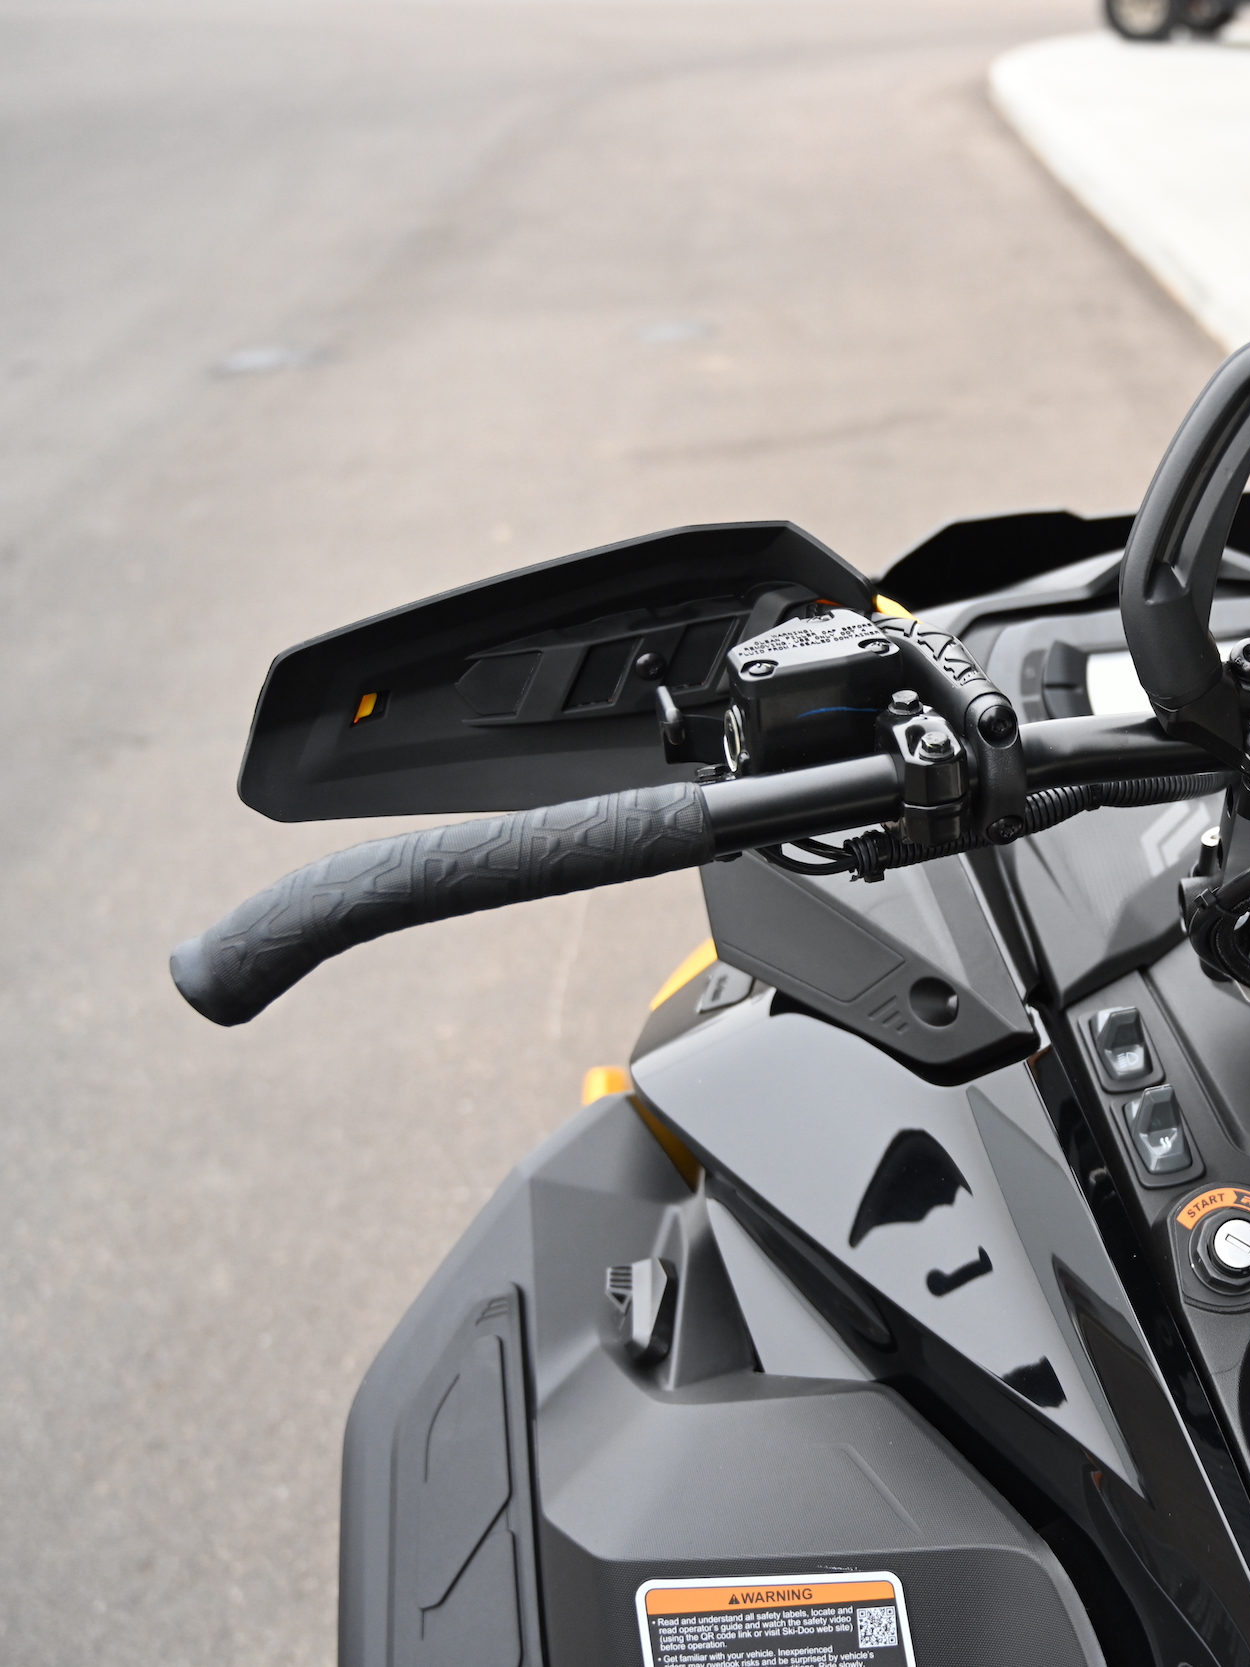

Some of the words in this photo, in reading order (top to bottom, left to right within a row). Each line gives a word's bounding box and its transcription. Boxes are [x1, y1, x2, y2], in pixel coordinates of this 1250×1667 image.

[738, 649, 765, 657] FLUID
[800, 637, 831, 647] SEALED
[834, 630, 881, 642] CONTAINER
[754, 636, 781, 646] CLEAN
[786, 632, 817, 641] FILLER
[842, 622, 873, 632] BEFORE
[795, 636, 810, 644] USE
[815, 633, 836, 641] ONLY
[1187, 1193, 1225, 1218] START
[741, 1588, 813, 1604] WARNING
[657, 1617, 680, 1627] Read
[681, 1616, 697, 1625] and
[698, 1612, 743, 1624] understand
[745, 1612, 755, 1621] all
[756, 1610, 781, 1622] safety
[782, 1609, 809, 1619] labels,
[811, 1607, 836, 1617] locate
[837, 1606, 854, 1615] and
[659, 1625, 678, 1635] read
[679, 1623, 720, 1635] operator's
[720, 1621, 743, 1633] guide
[744, 1620, 760, 1630] and
[761, 1619, 787, 1629] watch
[788, 1618, 801, 1627] the
[803, 1616, 828, 1628] safety
[829, 1615, 852, 1624] video
[660, 1634, 685, 1645] (using
[685, 1633, 699, 1642] the
[700, 1632, 715, 1641] QR
[716, 1630, 737, 1640] code
[738, 1629, 752, 1638] link
[753, 1630, 762, 1638] or
[764, 1627, 781, 1636] visit
[782, 1625, 815, 1635] Ski-Doo
[816, 1623, 834, 1633] web
[835, 1622, 854, 1633] site)
[660, 1642, 686, 1652] before
[687, 1641, 728, 1652] operation.
[663, 1654, 678, 1663] Get
[679, 1652, 708, 1662] familiar
[709, 1651, 726, 1660] with
[726, 1652, 744, 1661] your
[746, 1648, 776, 1659] vehicle.
[777, 1645, 833, 1658] Inexperienced
[706, 1659, 740, 1667] overlook
[741, 1659, 760, 1667] risks
[761, 1656, 777, 1666] and
[778, 1655, 789, 1665] be
[790, 1652, 827, 1665] surprised
[828, 1651, 839, 1662] by
[840, 1650, 875, 1661] vehicle's
